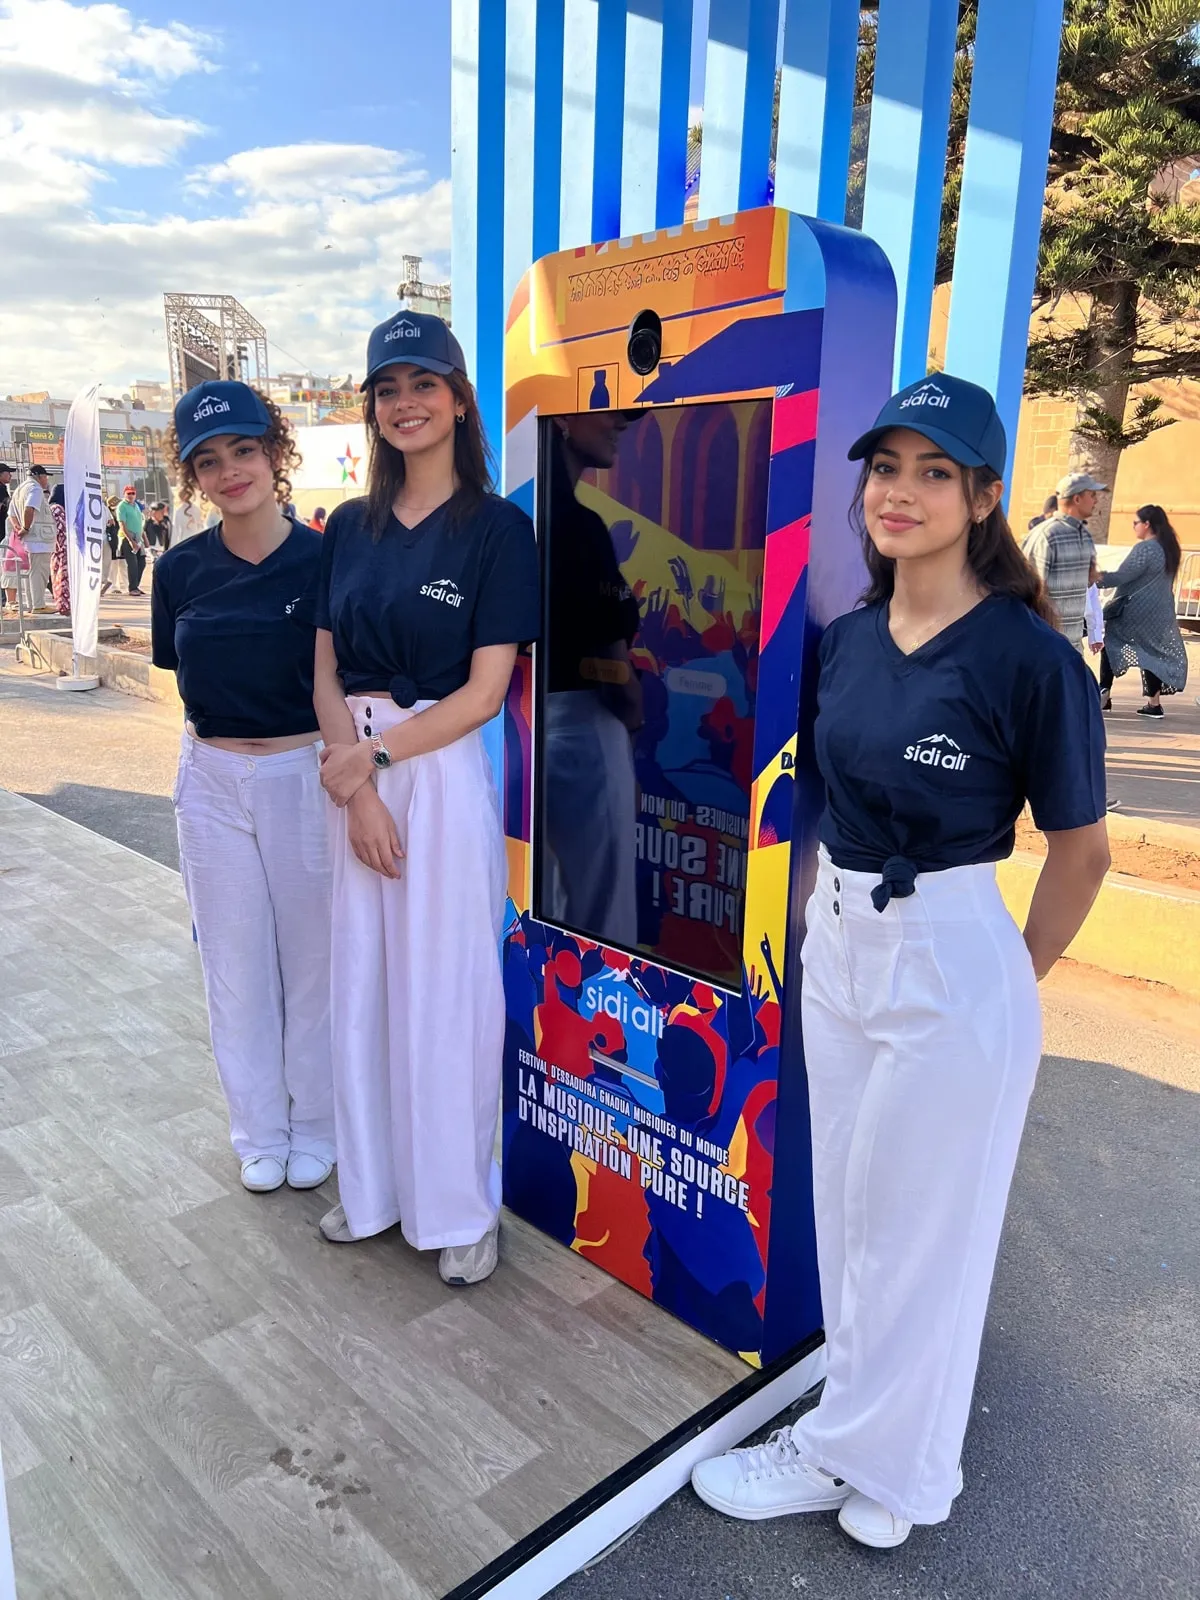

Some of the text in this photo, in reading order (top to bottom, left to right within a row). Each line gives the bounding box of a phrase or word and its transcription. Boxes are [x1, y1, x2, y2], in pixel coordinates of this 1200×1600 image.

[404, 327, 421, 338] ali
[927, 395, 951, 409] ali
[85, 471, 103, 591] sidi ali
[419, 584, 462, 608] sidi ali
[903, 745, 967, 771] sidi ali
[586, 985, 664, 1039] sidi ali
[518, 1048, 548, 1075] FESTIVAL
[600, 1089, 631, 1117] GNAOUA
[633, 1105, 677, 1140] MUSIQUES
[680, 1128, 693, 1147] DU
[696, 1136, 729, 1166] MONDE
[518, 1067, 750, 1213] LA MUSIQUE, UNE SOURCE
[518, 1094, 704, 1219] D'INSPIRATION PURE !
